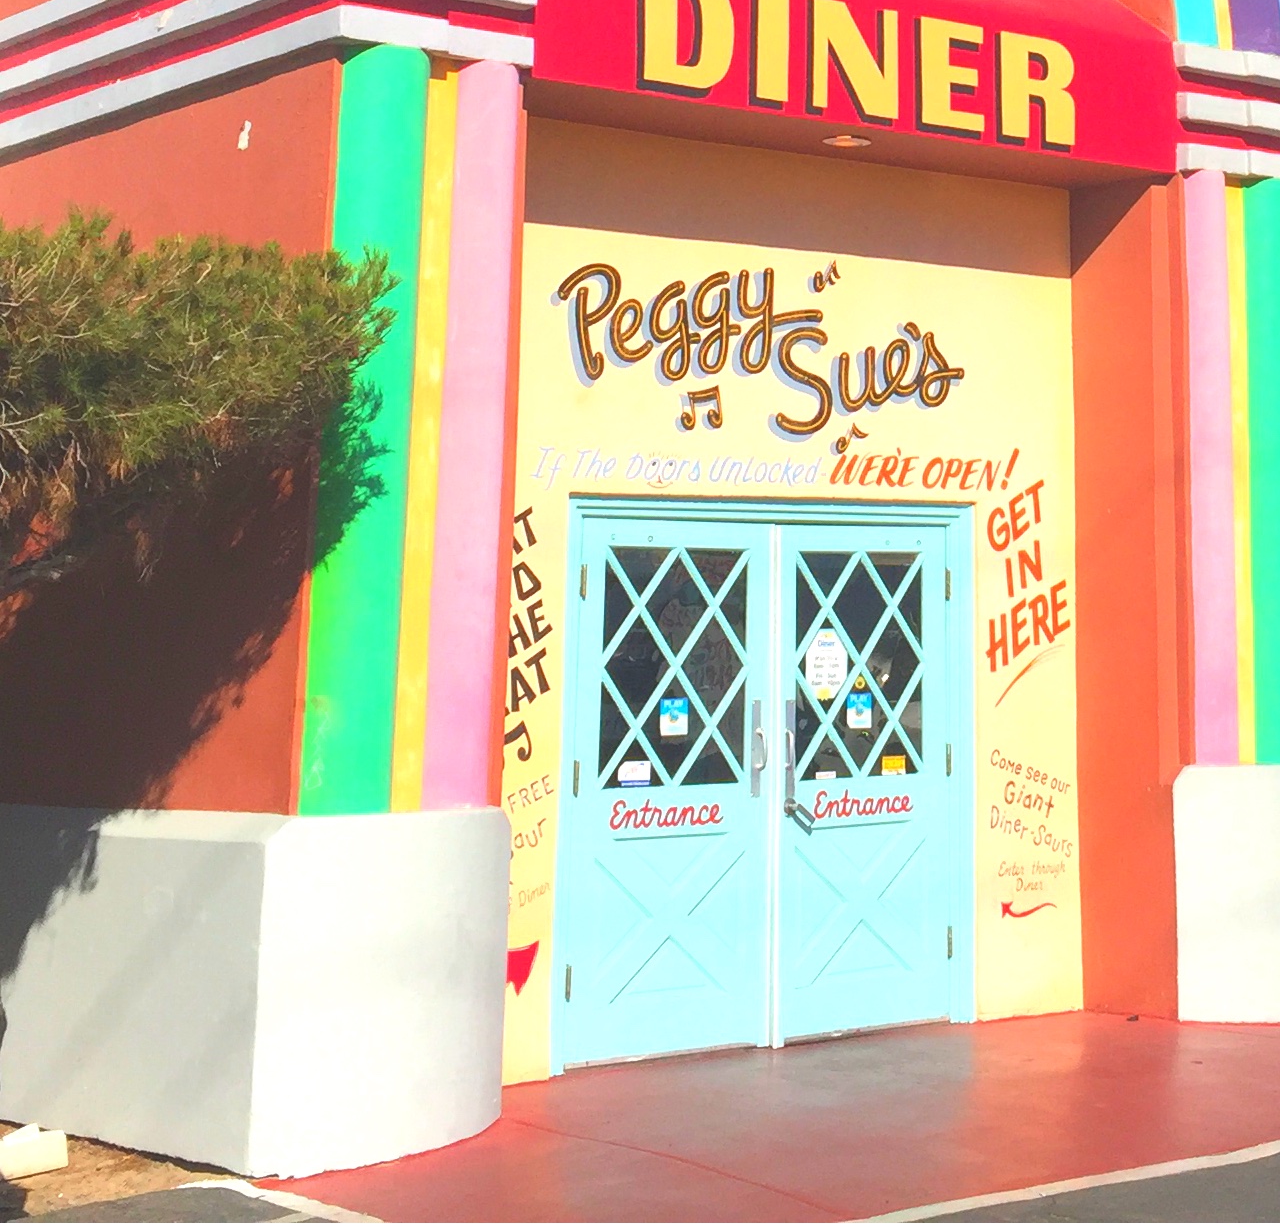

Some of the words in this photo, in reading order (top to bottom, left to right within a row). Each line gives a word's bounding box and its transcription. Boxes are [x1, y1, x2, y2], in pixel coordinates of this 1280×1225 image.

[555, 263, 823, 383] Peggy
[773, 321, 965, 436] Sue's
[531, 446, 567, 491] If
[573, 448, 617, 480] The
[626, 452, 701, 482] Doors
[921, 448, 1020, 491] OPEN!
[986, 479, 1044, 552] GET
[512, 561, 542, 602] D
[1005, 540, 1043, 598] IN
[508, 598, 553, 659] HE
[985, 579, 1071, 673] HERE
[505, 647, 551, 715] AT
[507, 774, 554, 814] FREE
[1003, 780, 1054, 819] Giant
[1025, 766, 1048, 785] see
[1050, 777, 1071, 794] our
[609, 798, 724, 830] Entrance
[813, 788, 914, 819] Entrance
[511, 818, 547, 856] aur
[1015, 878, 1044, 892] Diner
[1031, 860, 1066, 878] through
[518, 882, 552, 908] Diner
